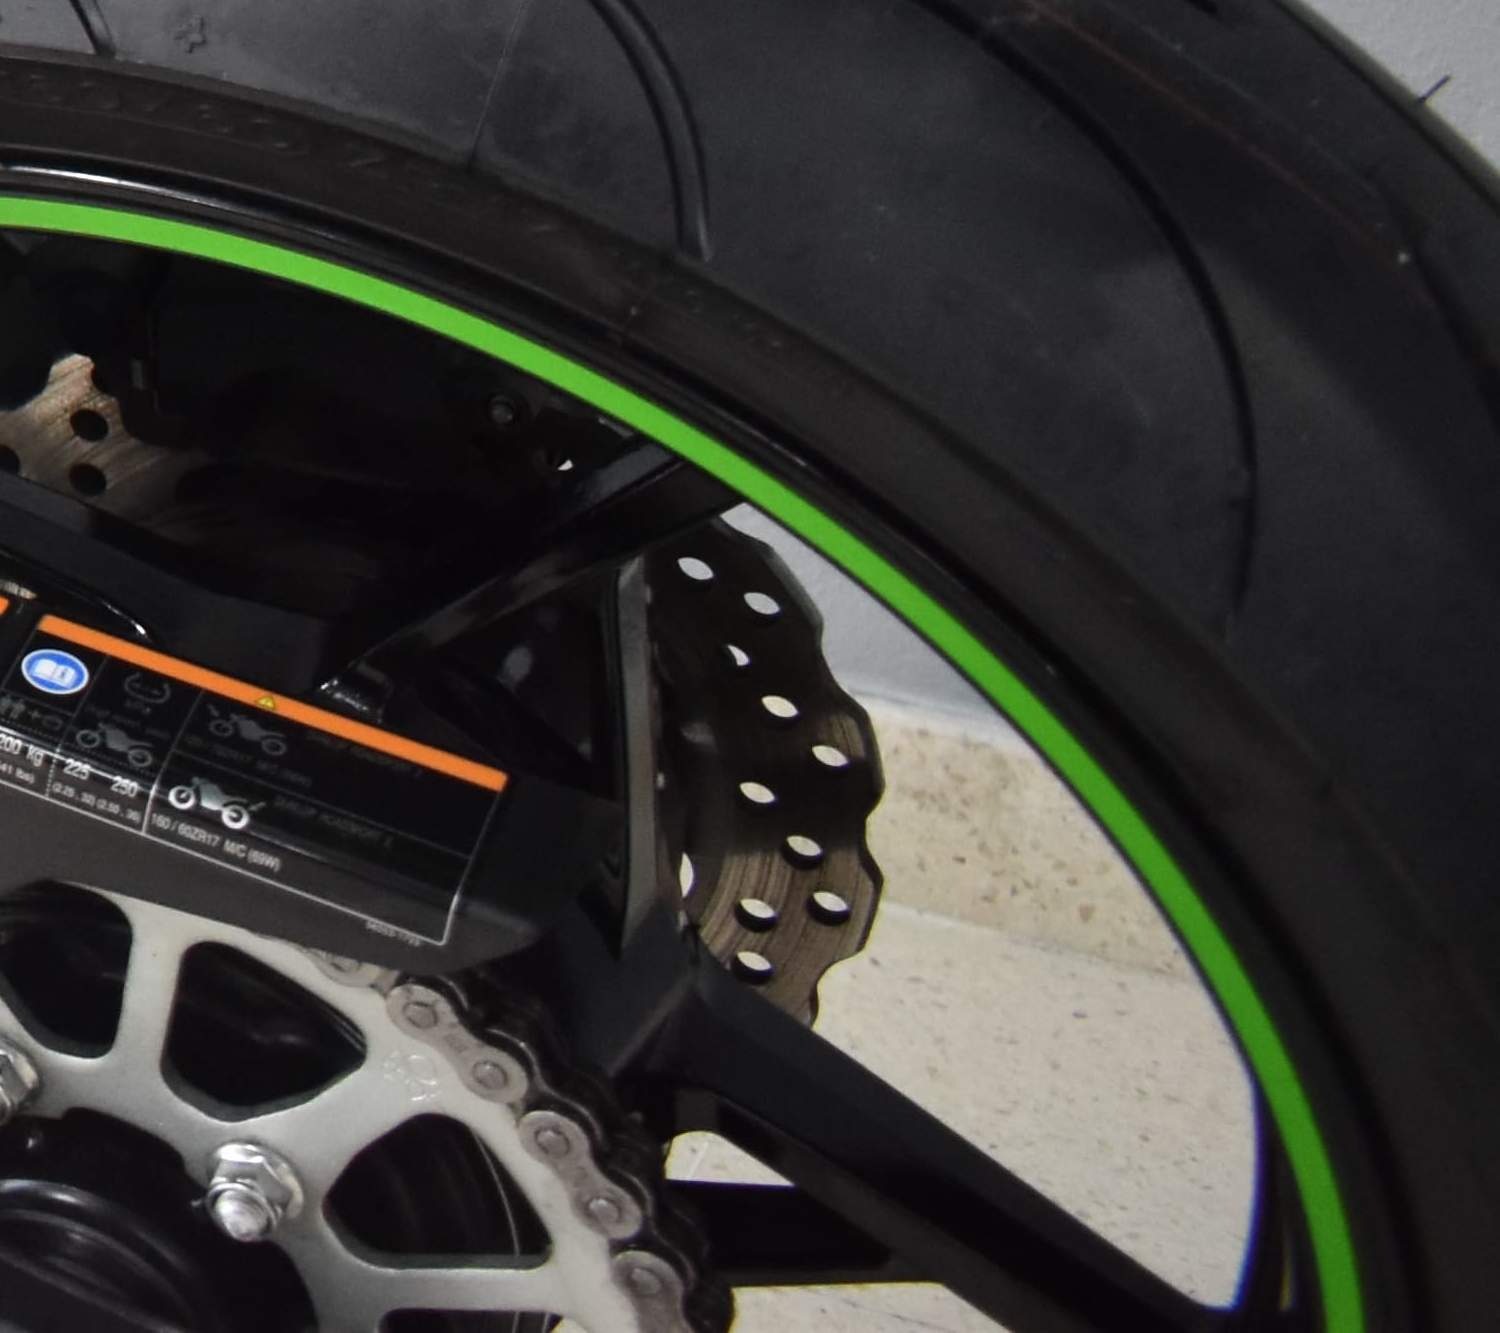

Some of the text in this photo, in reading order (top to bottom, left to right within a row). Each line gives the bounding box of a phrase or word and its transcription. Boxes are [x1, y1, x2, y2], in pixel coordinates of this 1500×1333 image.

[26, 744, 44, 767] kg
[63, 758, 140, 798] 225 250
